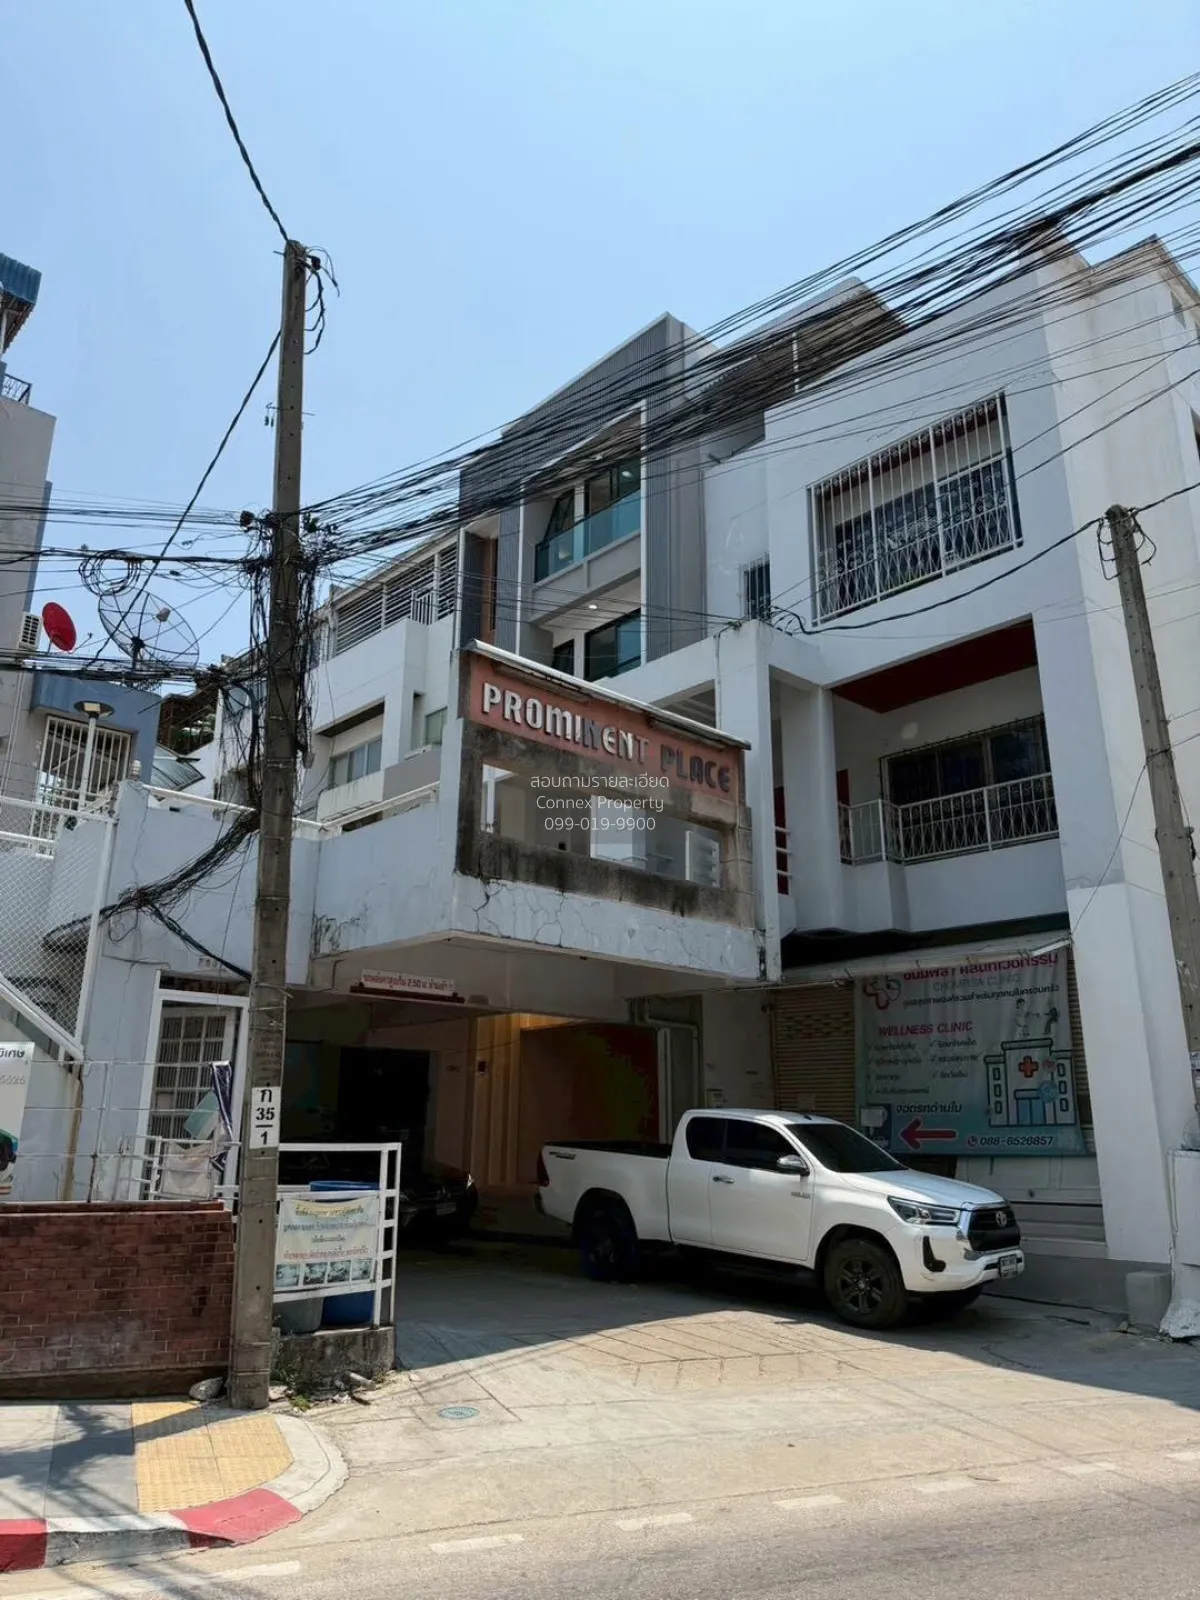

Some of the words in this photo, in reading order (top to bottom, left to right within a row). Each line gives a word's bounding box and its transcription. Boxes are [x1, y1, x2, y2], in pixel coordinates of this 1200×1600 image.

[482, 682, 649, 764] PROMINENT
[660, 744, 731, 792] PLACE
[878, 1024, 933, 1037] WELLNESS
[937, 1020, 973, 1033] CLINIC
[255, 1107, 275, 1121] 35
[260, 1130, 268, 1145] 1
